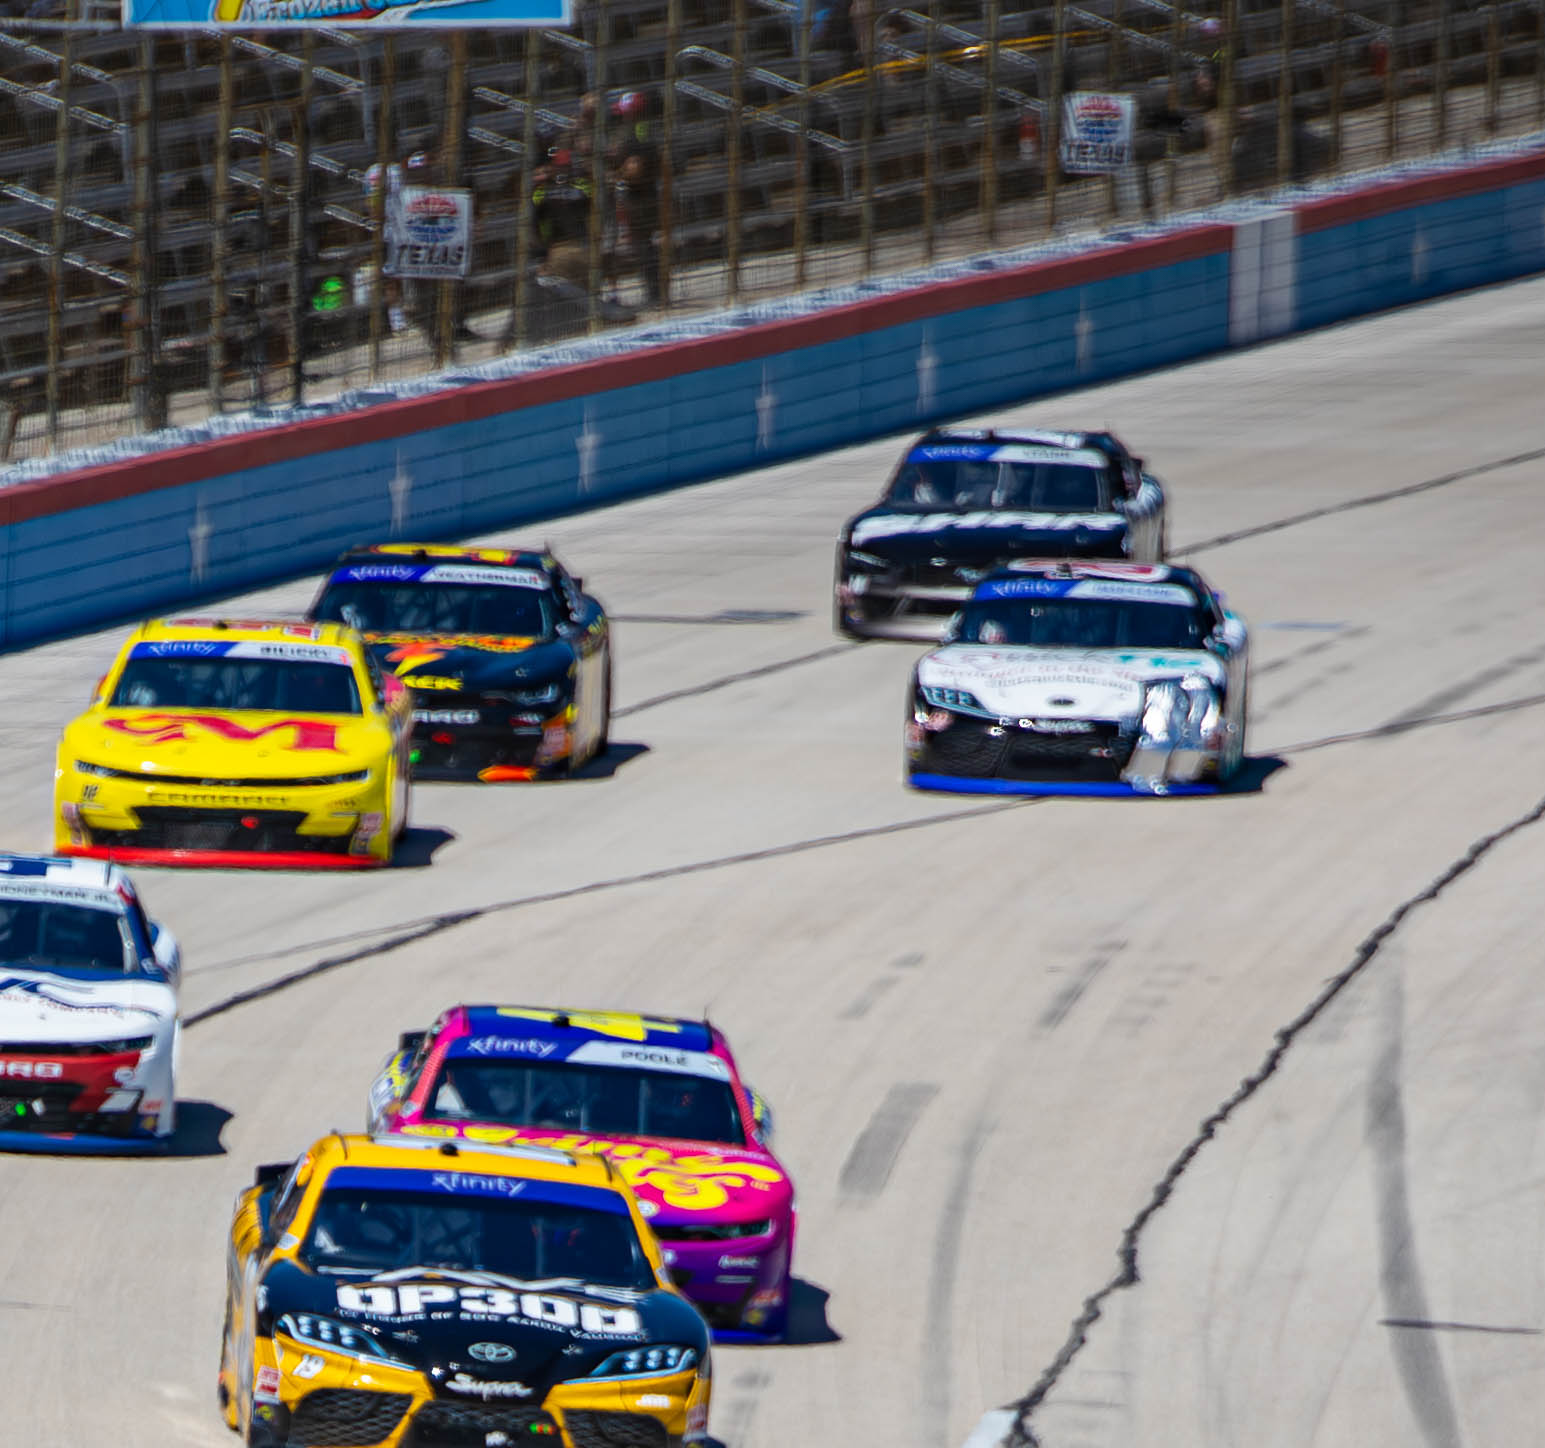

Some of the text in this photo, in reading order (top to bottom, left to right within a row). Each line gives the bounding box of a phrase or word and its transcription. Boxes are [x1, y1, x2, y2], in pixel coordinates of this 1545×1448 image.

[468, 1036, 559, 1057] xfinity
[621, 1050, 689, 1067] POOLE
[432, 1171, 528, 1198] xfinity
[444, 1372, 534, 1402] Supra
